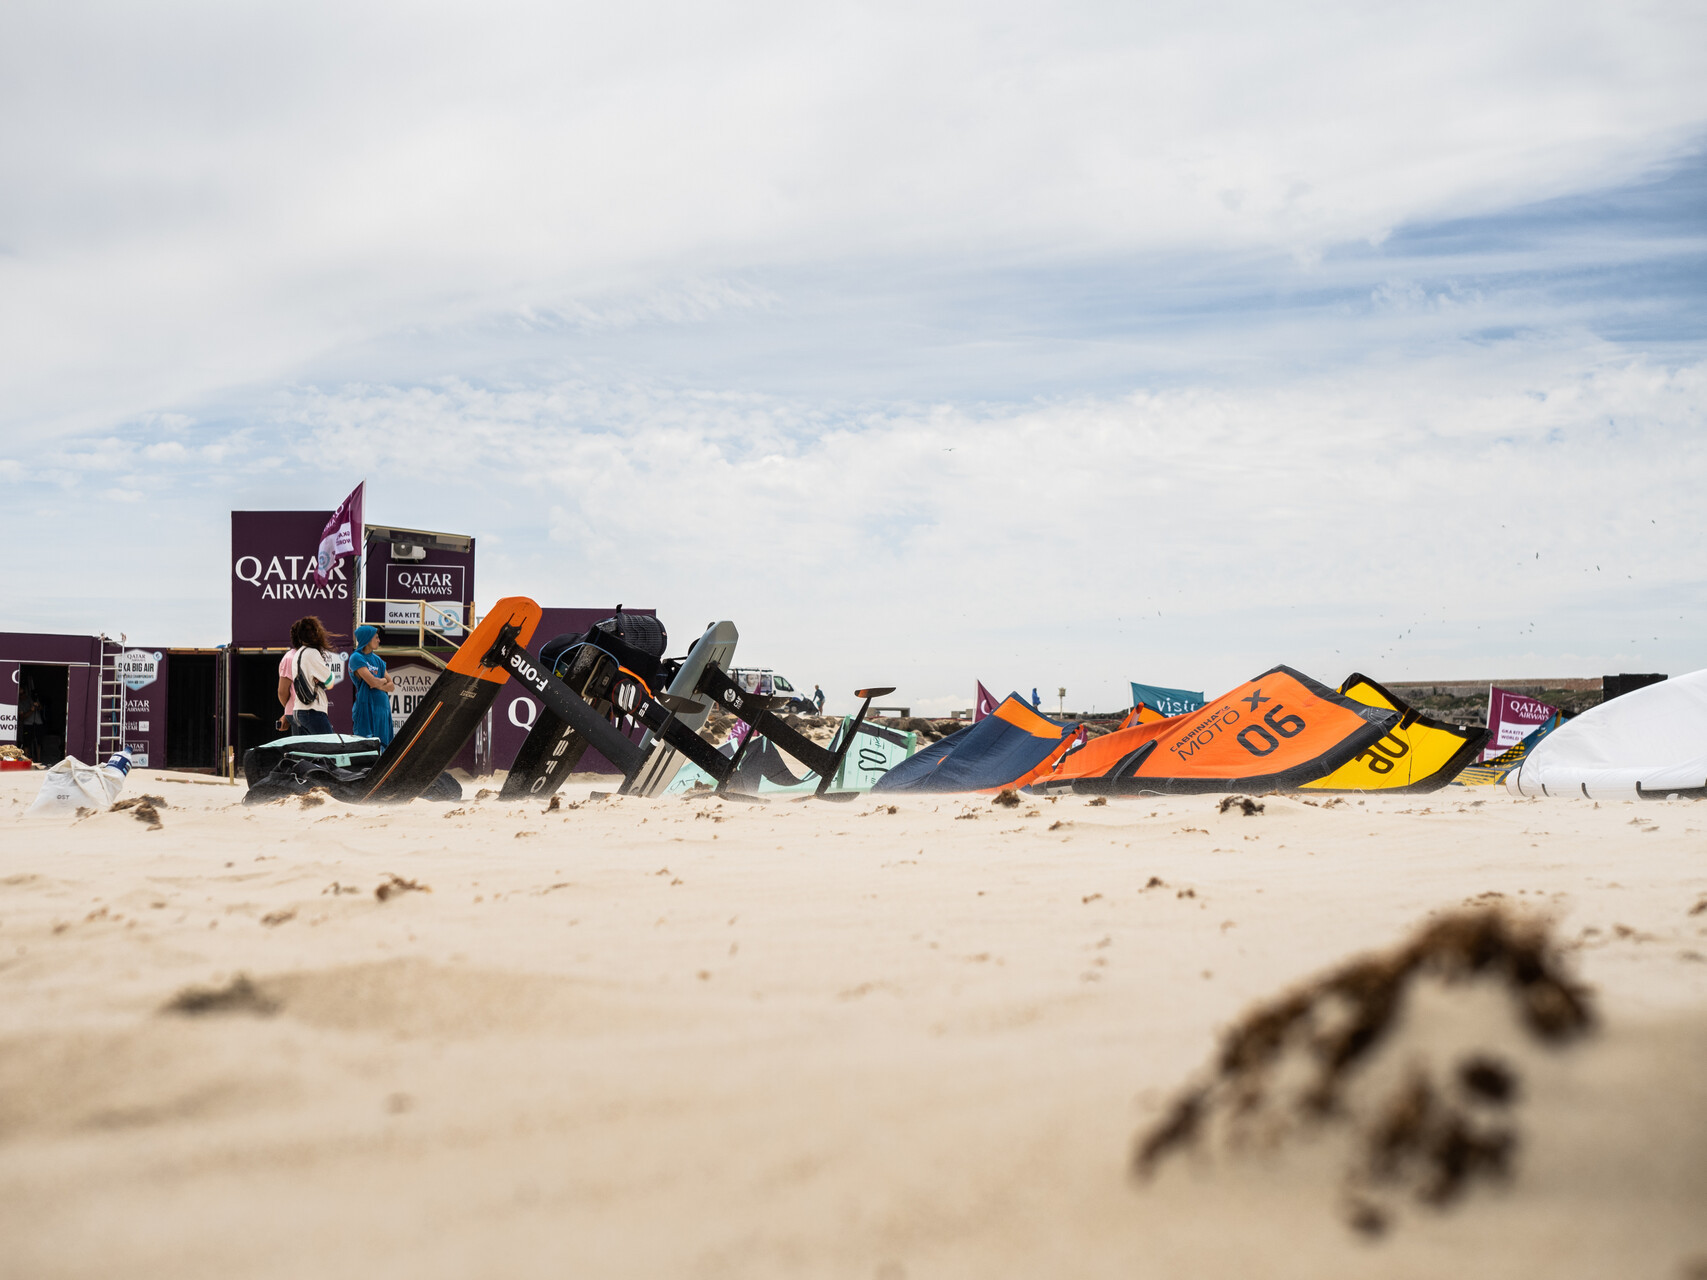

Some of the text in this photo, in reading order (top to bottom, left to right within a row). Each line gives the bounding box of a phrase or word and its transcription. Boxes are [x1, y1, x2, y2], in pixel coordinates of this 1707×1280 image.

[398, 572, 452, 588] QATAR
[261, 583, 348, 600] AIRWAYS
[411, 586, 453, 595] AIRWAYS
[132, 662, 143, 672] BIG
[144, 662, 155, 672] AIR
[331, 663, 341, 672] AIR
[392, 675, 432, 687] QATAR
[1510, 700, 1550, 714] QATAR
[1177, 688, 1271, 761] MOTO X
[1236, 704, 1306, 757] 06
[1170, 714, 1219, 753] CABRINHA
